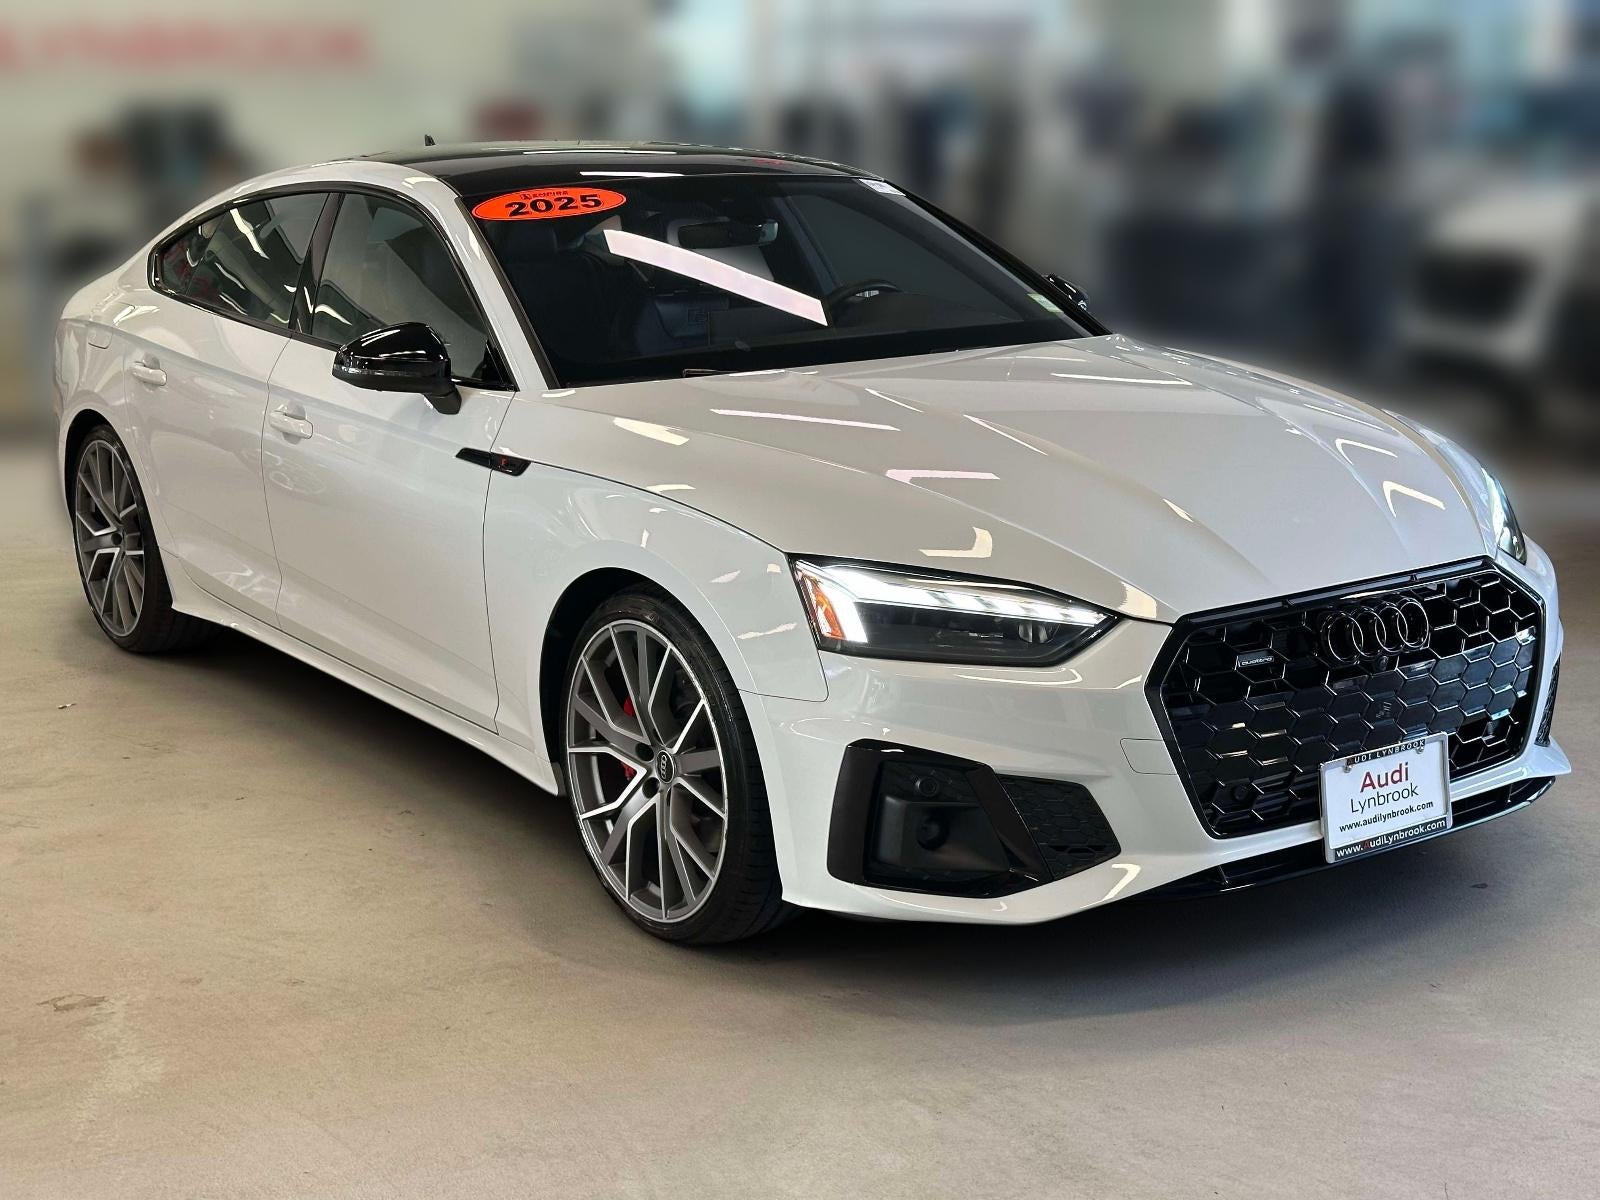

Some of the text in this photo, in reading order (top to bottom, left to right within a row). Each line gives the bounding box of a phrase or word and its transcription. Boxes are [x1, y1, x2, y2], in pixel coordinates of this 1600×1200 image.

[504, 194, 603, 217] 2025
[1241, 656, 1274, 667] quattro
[1376, 739, 1426, 758] LYNBROOK
[1360, 762, 1409, 793] Audi
[1351, 782, 1419, 814] Lynbrook
[1339, 800, 1434, 832] www.audilynbrook.com
[1336, 819, 1446, 858] www.AudiLynbrook.com
